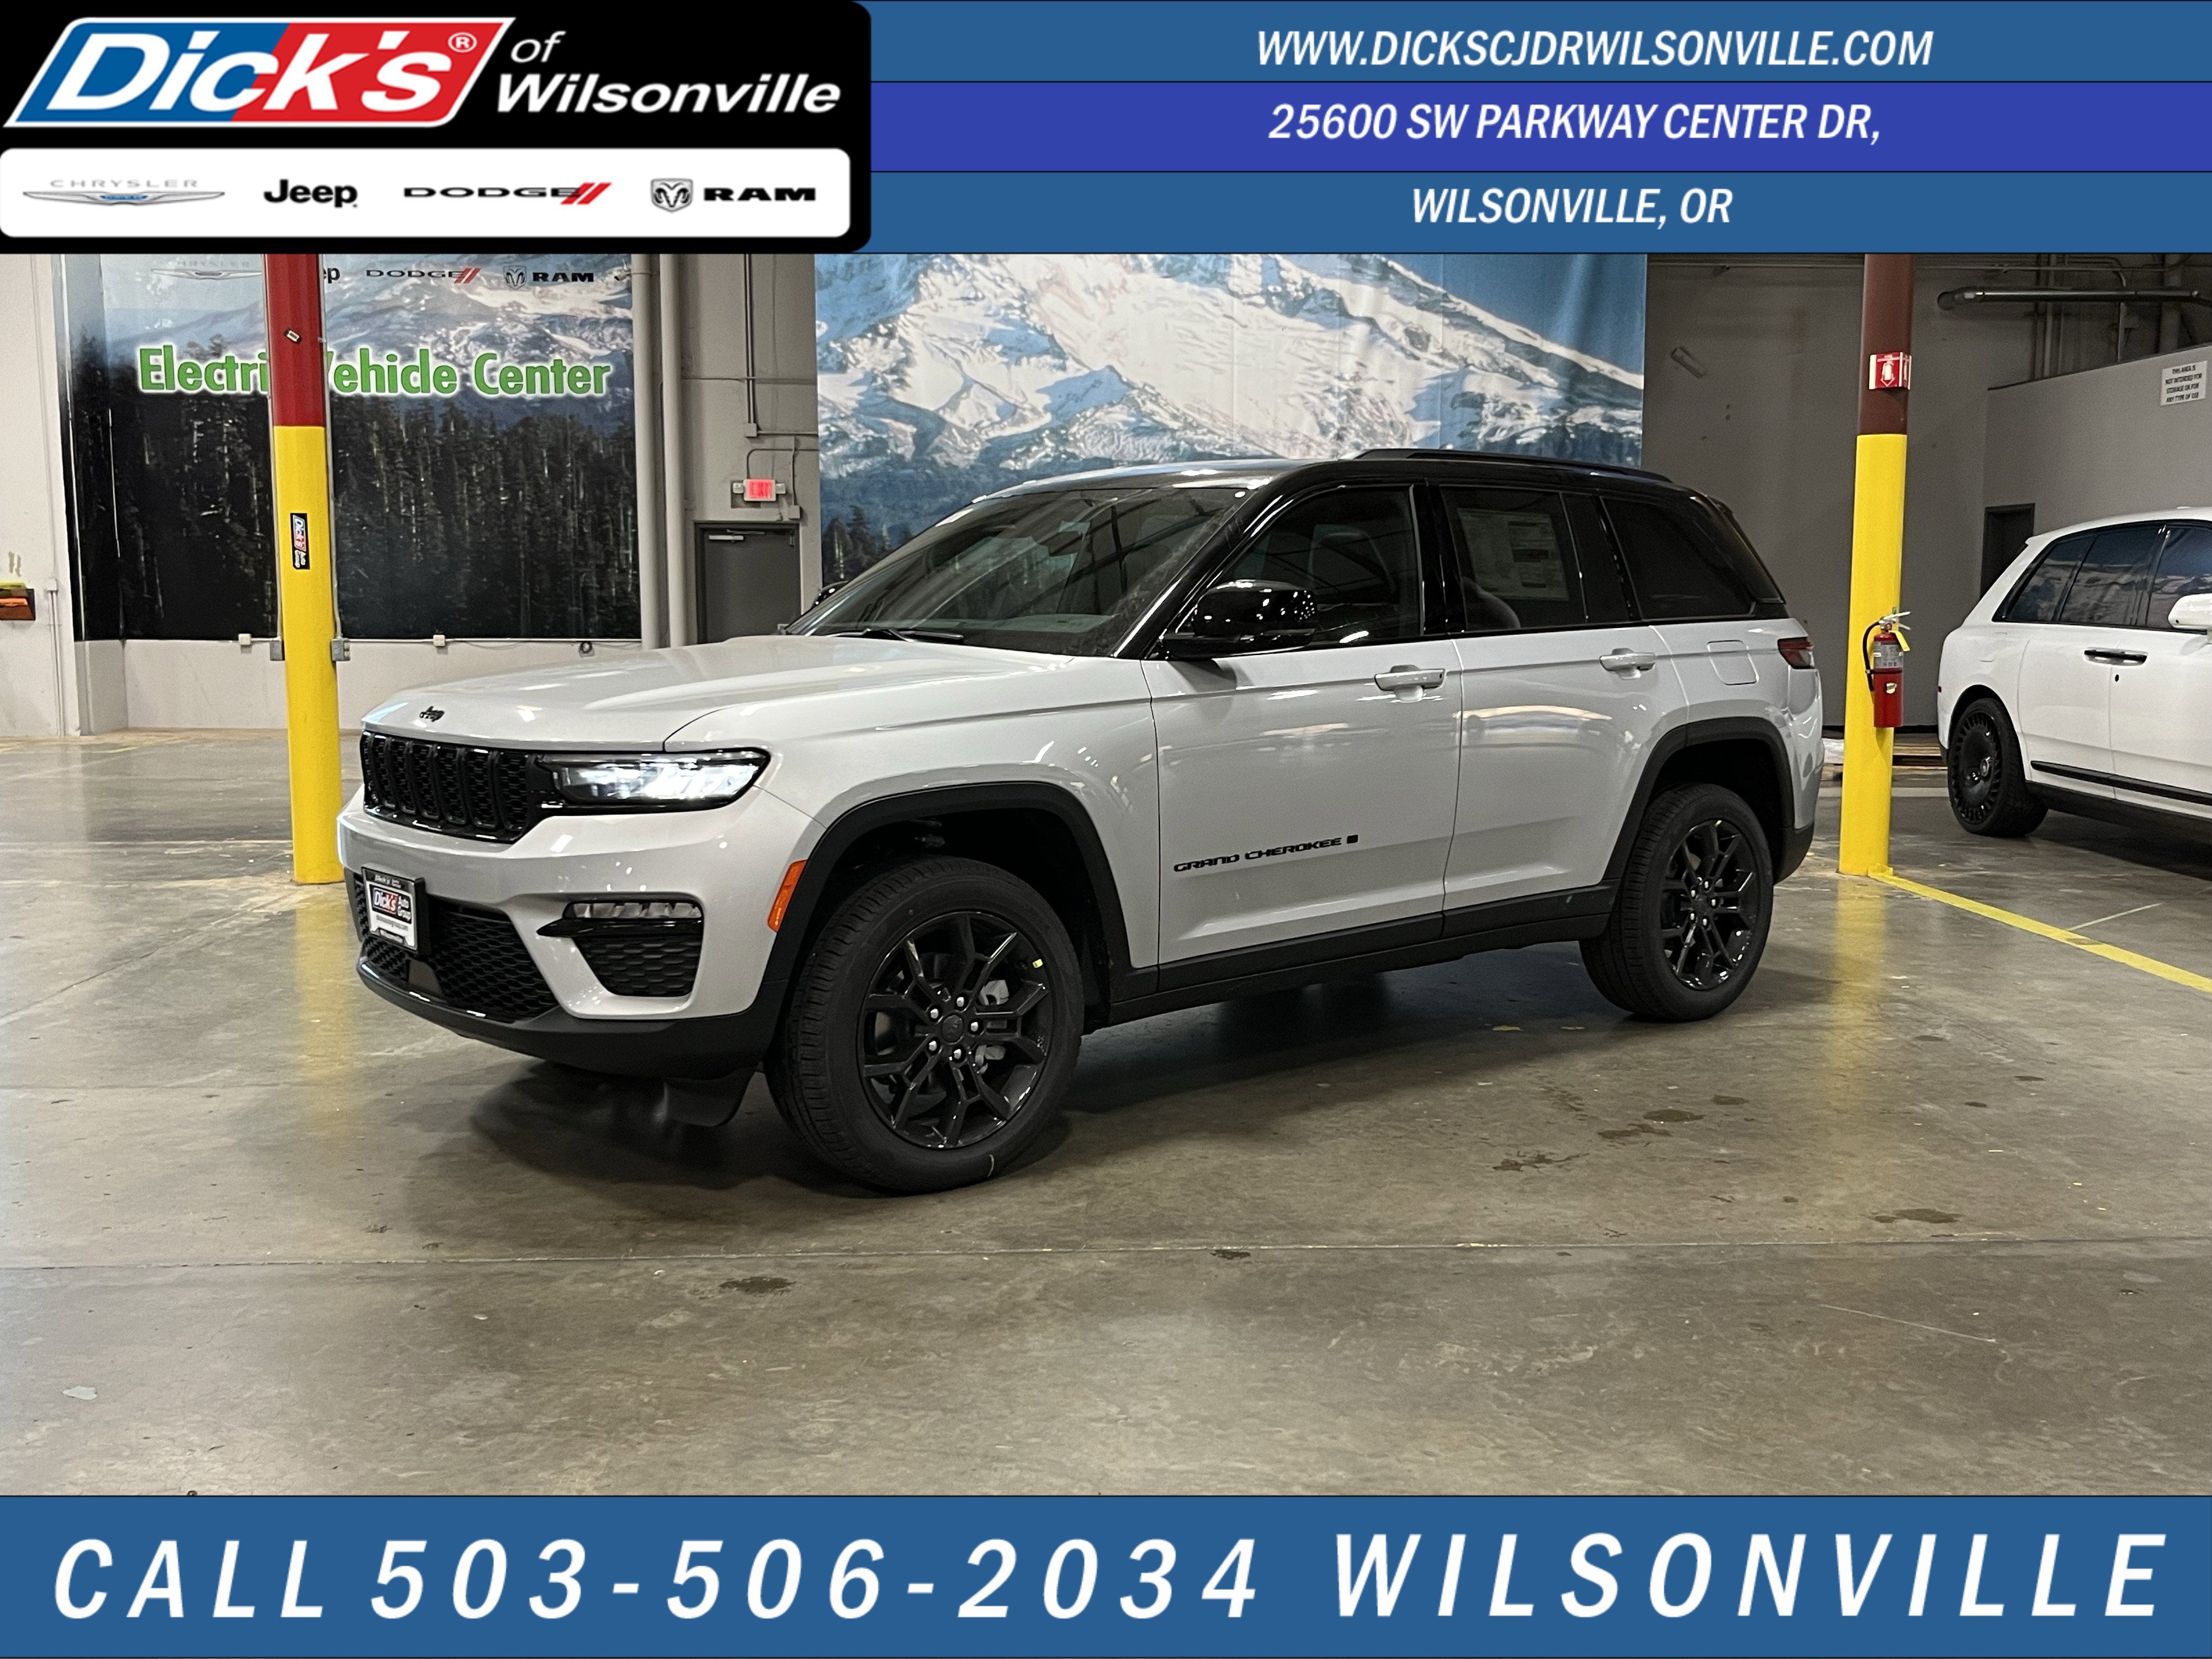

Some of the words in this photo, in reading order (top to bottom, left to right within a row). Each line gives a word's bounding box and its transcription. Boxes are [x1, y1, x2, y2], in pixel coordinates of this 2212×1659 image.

[366, 269, 464, 279] DODGE
[532, 272, 595, 283] RAM
[139, 345, 268, 392] Electri
[328, 347, 457, 394] ehicle
[474, 352, 611, 395] Center
[1173, 854, 1240, 872] GRAND
[1244, 837, 1342, 860] CHEROKEE
